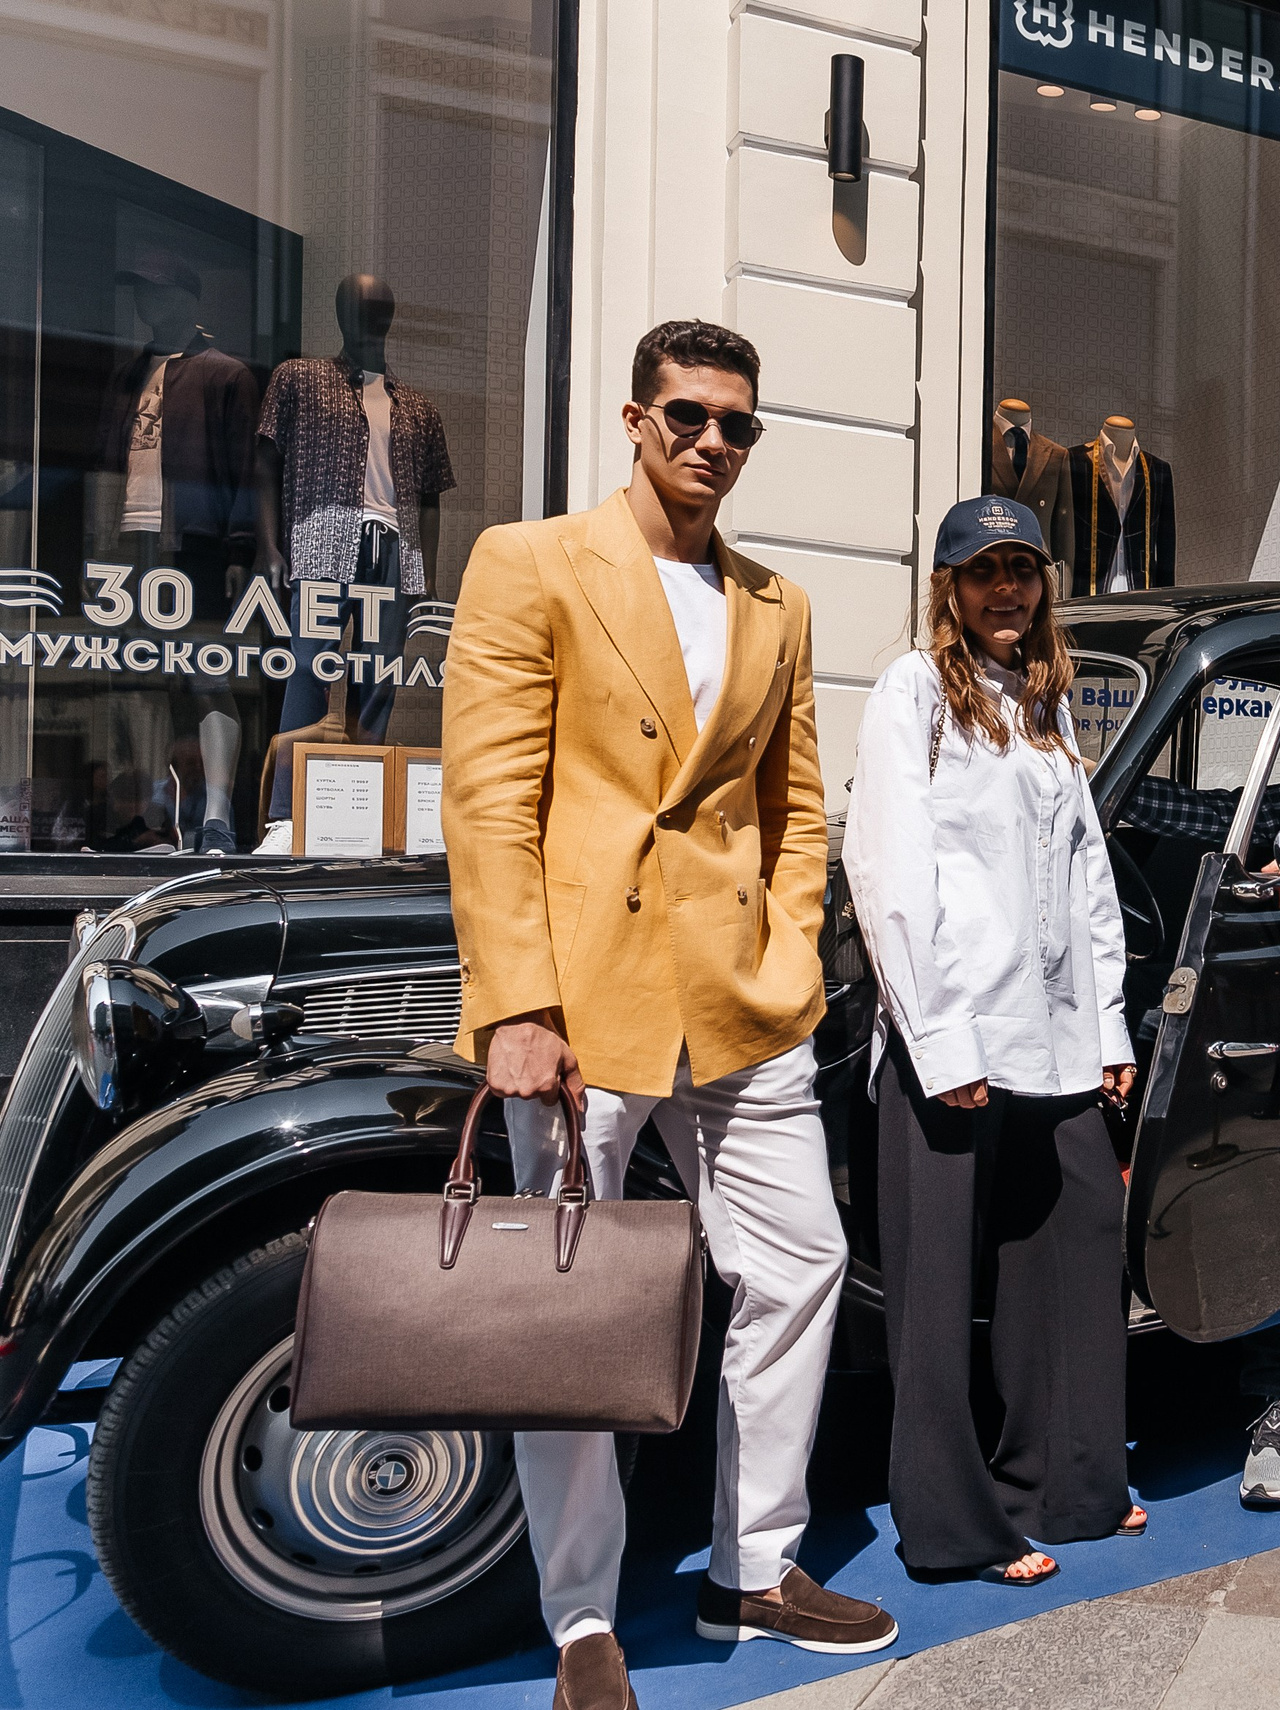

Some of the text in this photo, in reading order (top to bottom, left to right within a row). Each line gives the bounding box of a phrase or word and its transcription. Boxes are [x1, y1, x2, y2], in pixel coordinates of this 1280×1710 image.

[82, 562, 396, 643] 30 ЛЕТ
[0, 632, 297, 680] МУЖСКОГО
[0, 815, 30, 823] АША
